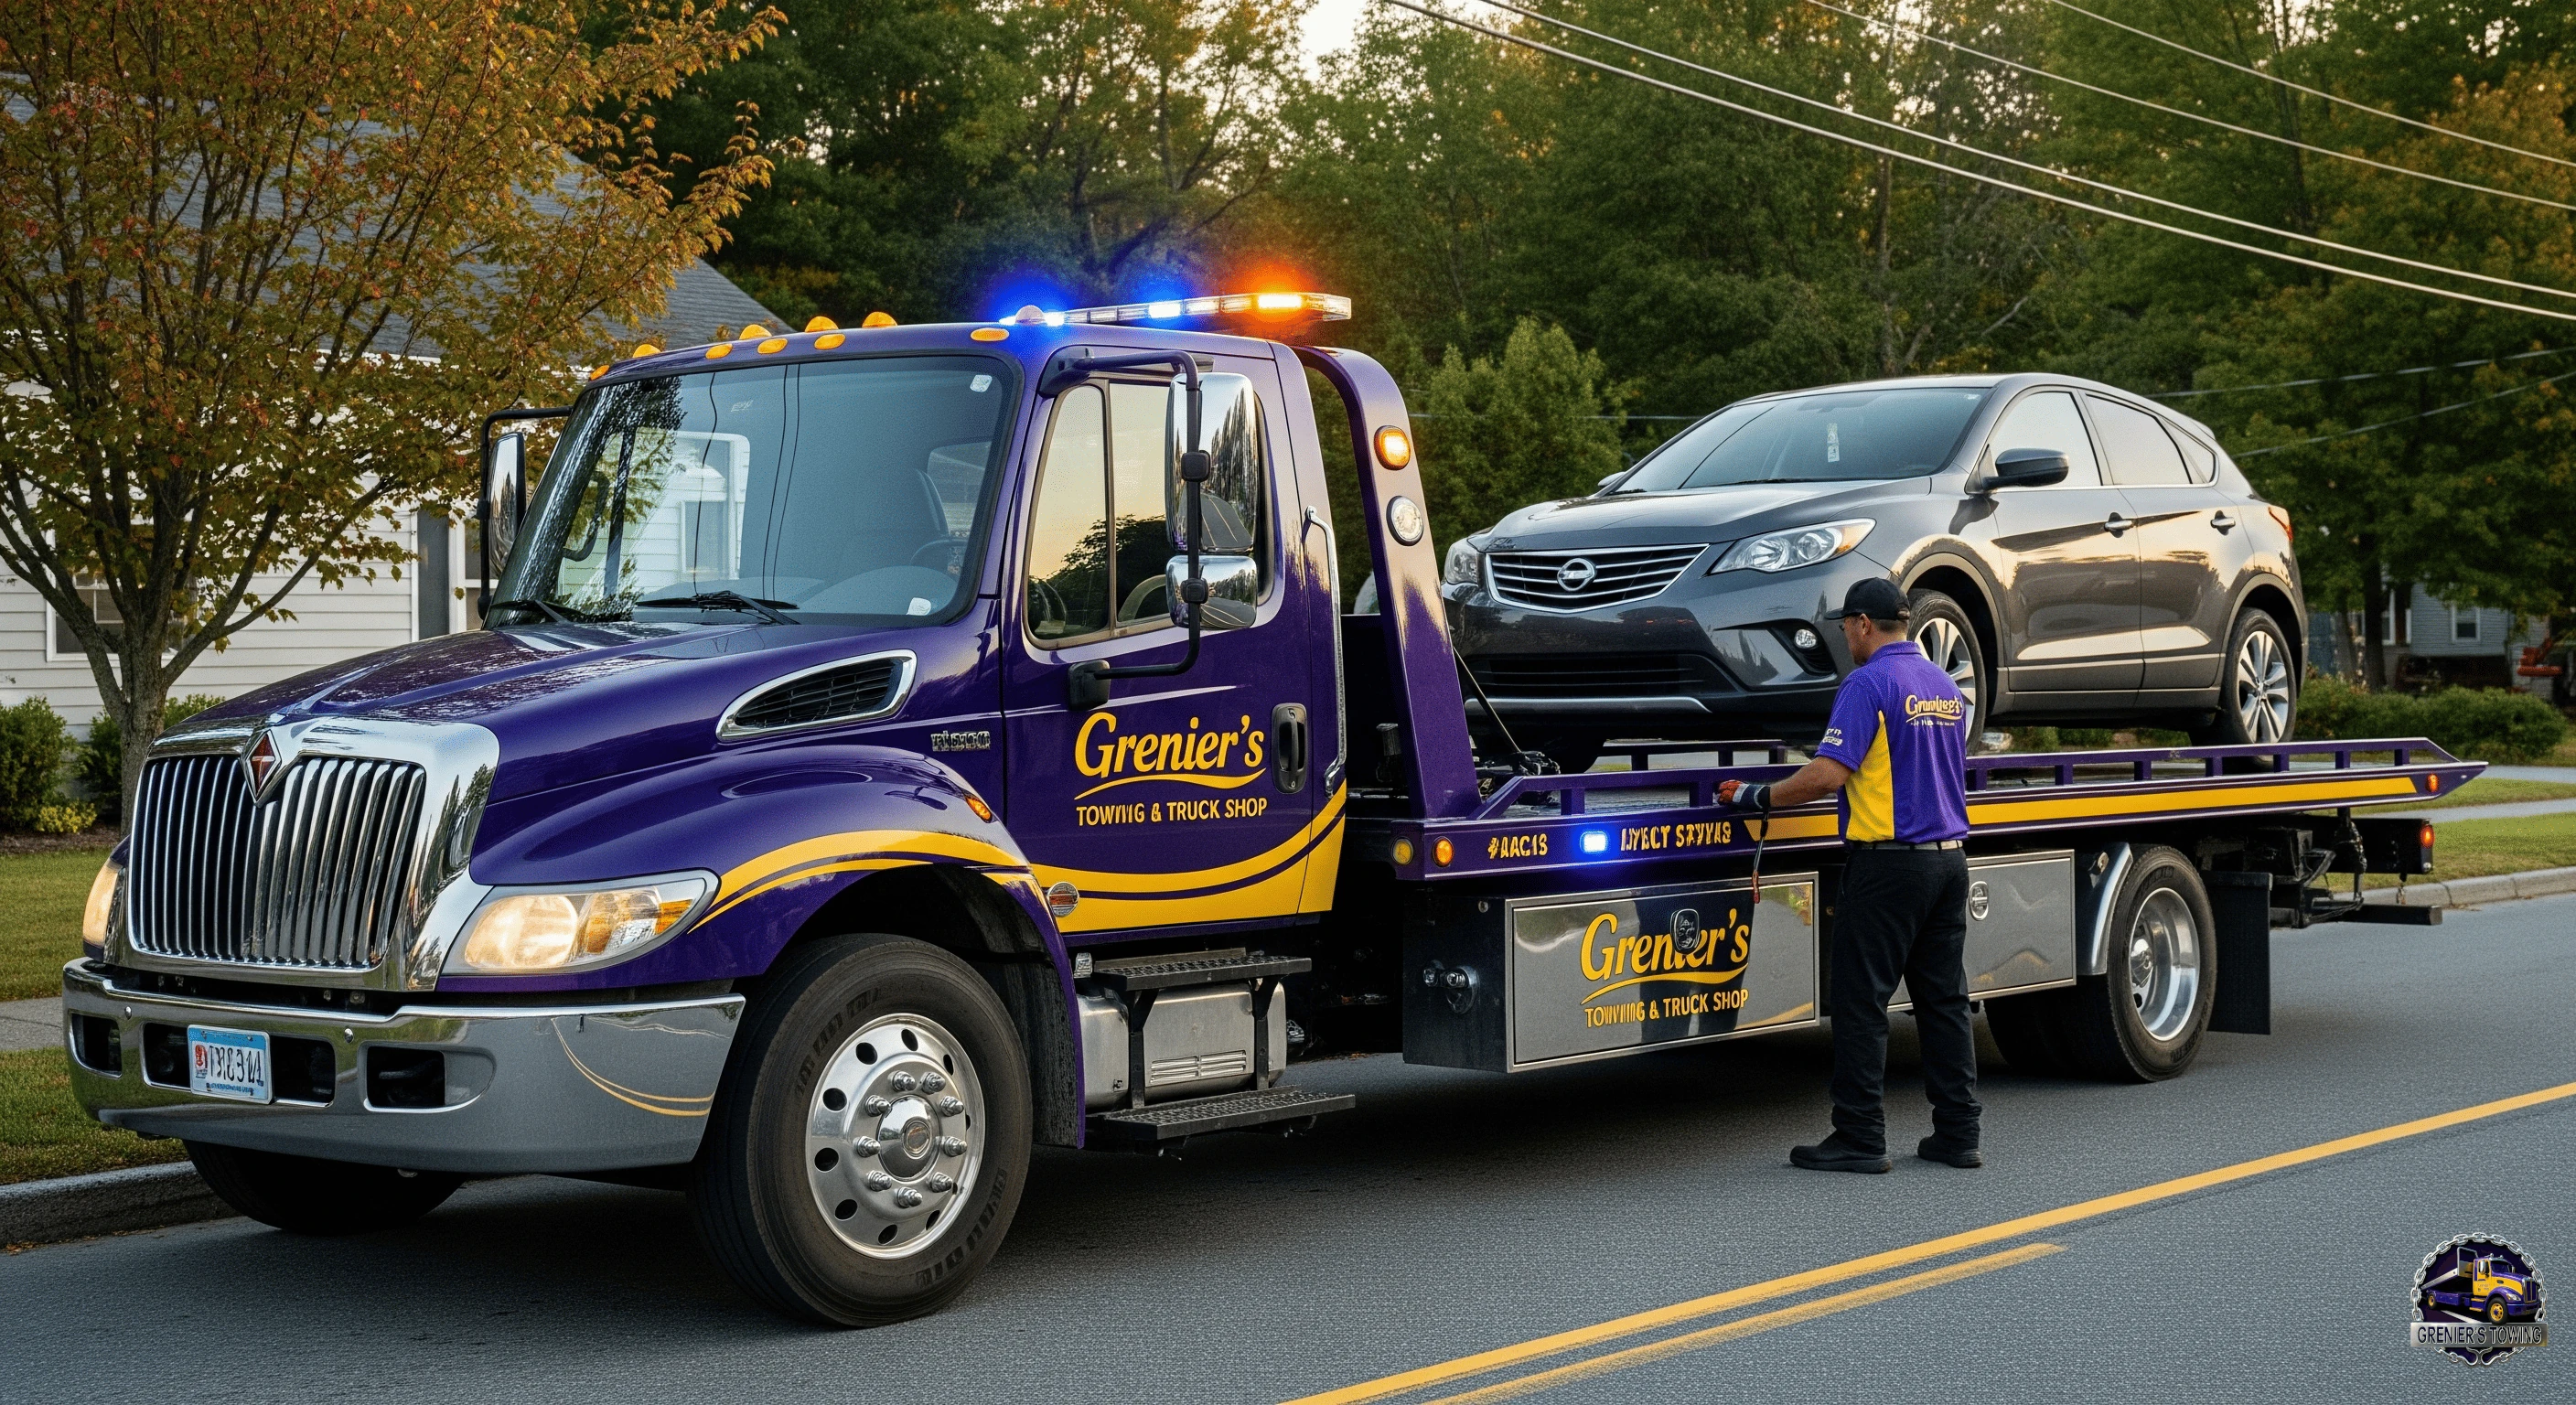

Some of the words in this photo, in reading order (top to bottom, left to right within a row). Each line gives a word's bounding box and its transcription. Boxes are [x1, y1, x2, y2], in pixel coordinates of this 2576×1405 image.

[1074, 712, 1264, 778] Grenier's
[1151, 803, 1162, 822] &
[1166, 799, 1220, 821] TRUCK
[1225, 798, 1268, 819] SHOP
[1649, 1000, 1659, 1021] &
[1663, 993, 1709, 1018] TRUCK
[1713, 989, 1749, 1011] SHOP
